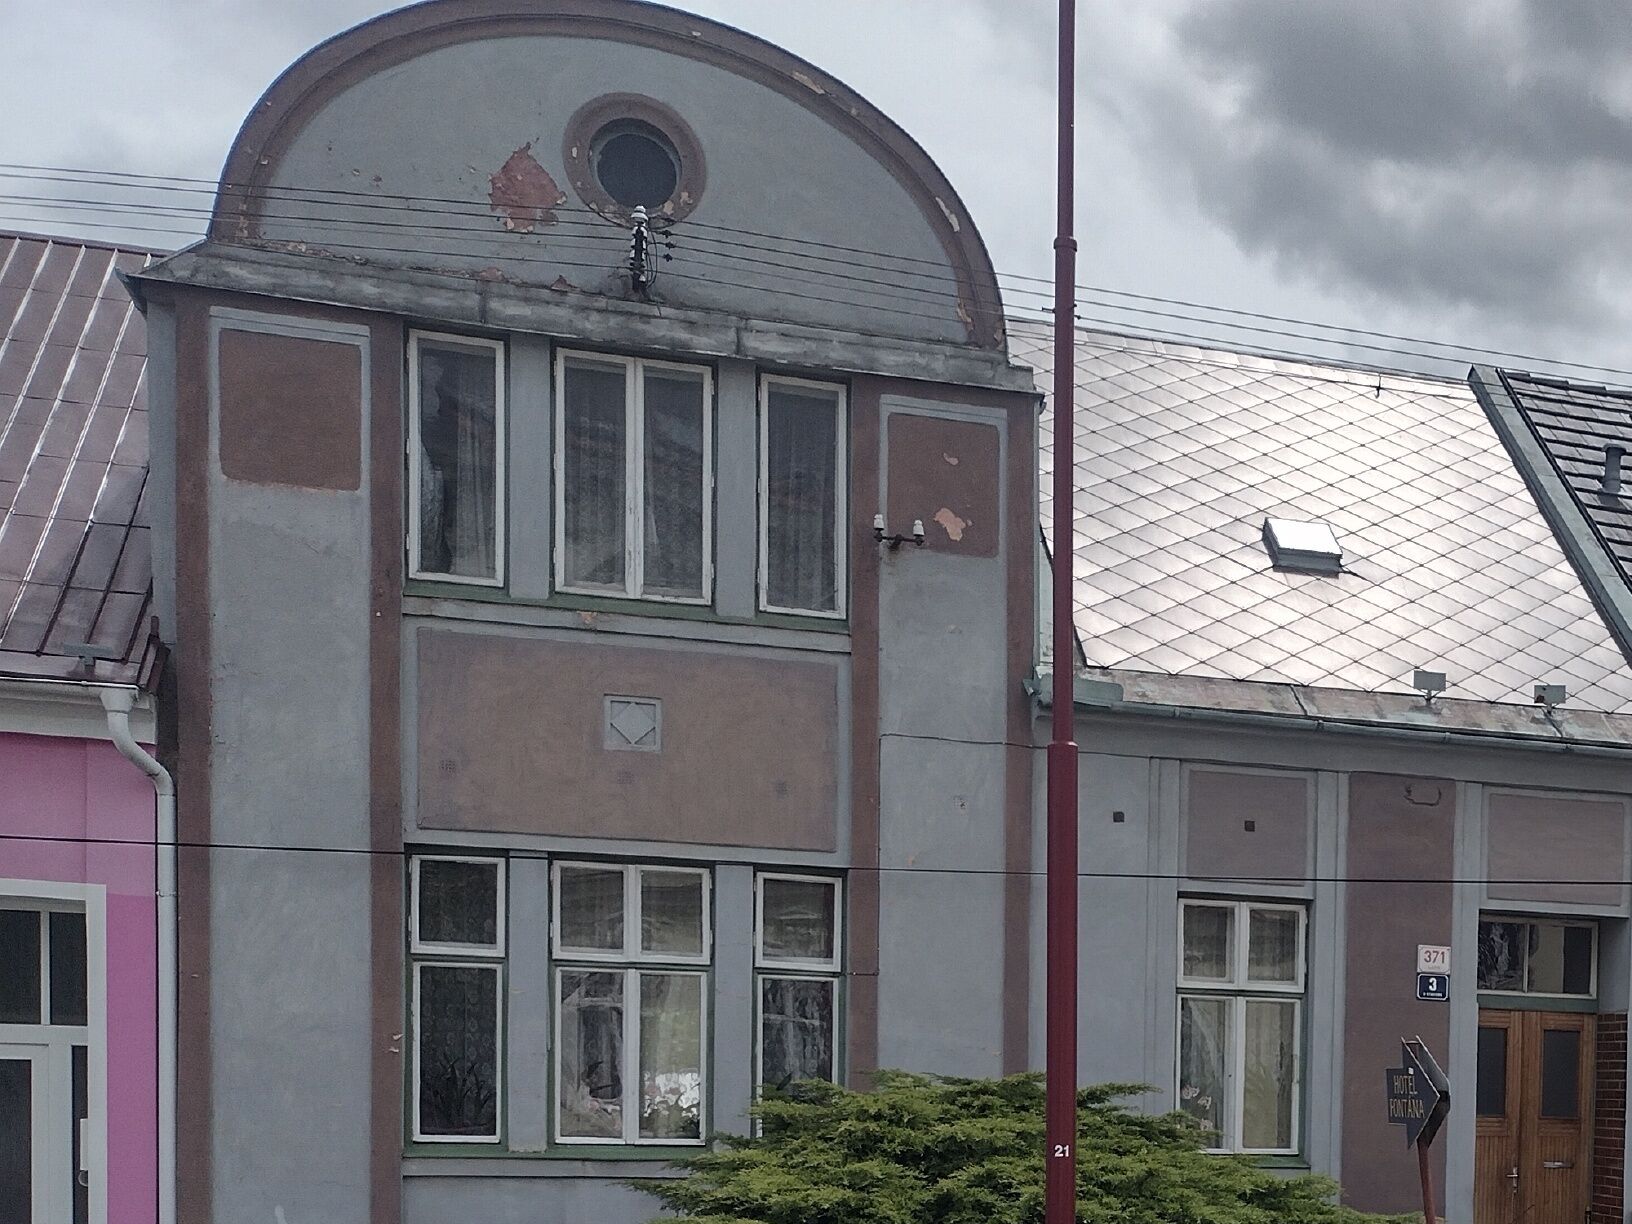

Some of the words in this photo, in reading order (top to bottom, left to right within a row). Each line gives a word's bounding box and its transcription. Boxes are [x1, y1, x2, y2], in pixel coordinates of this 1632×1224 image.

[1424, 950, 1445, 964] 371
[1428, 977, 1437, 991] 3
[1393, 1075, 1418, 1094] HOTEL
[1054, 1144, 1070, 1158] 21
